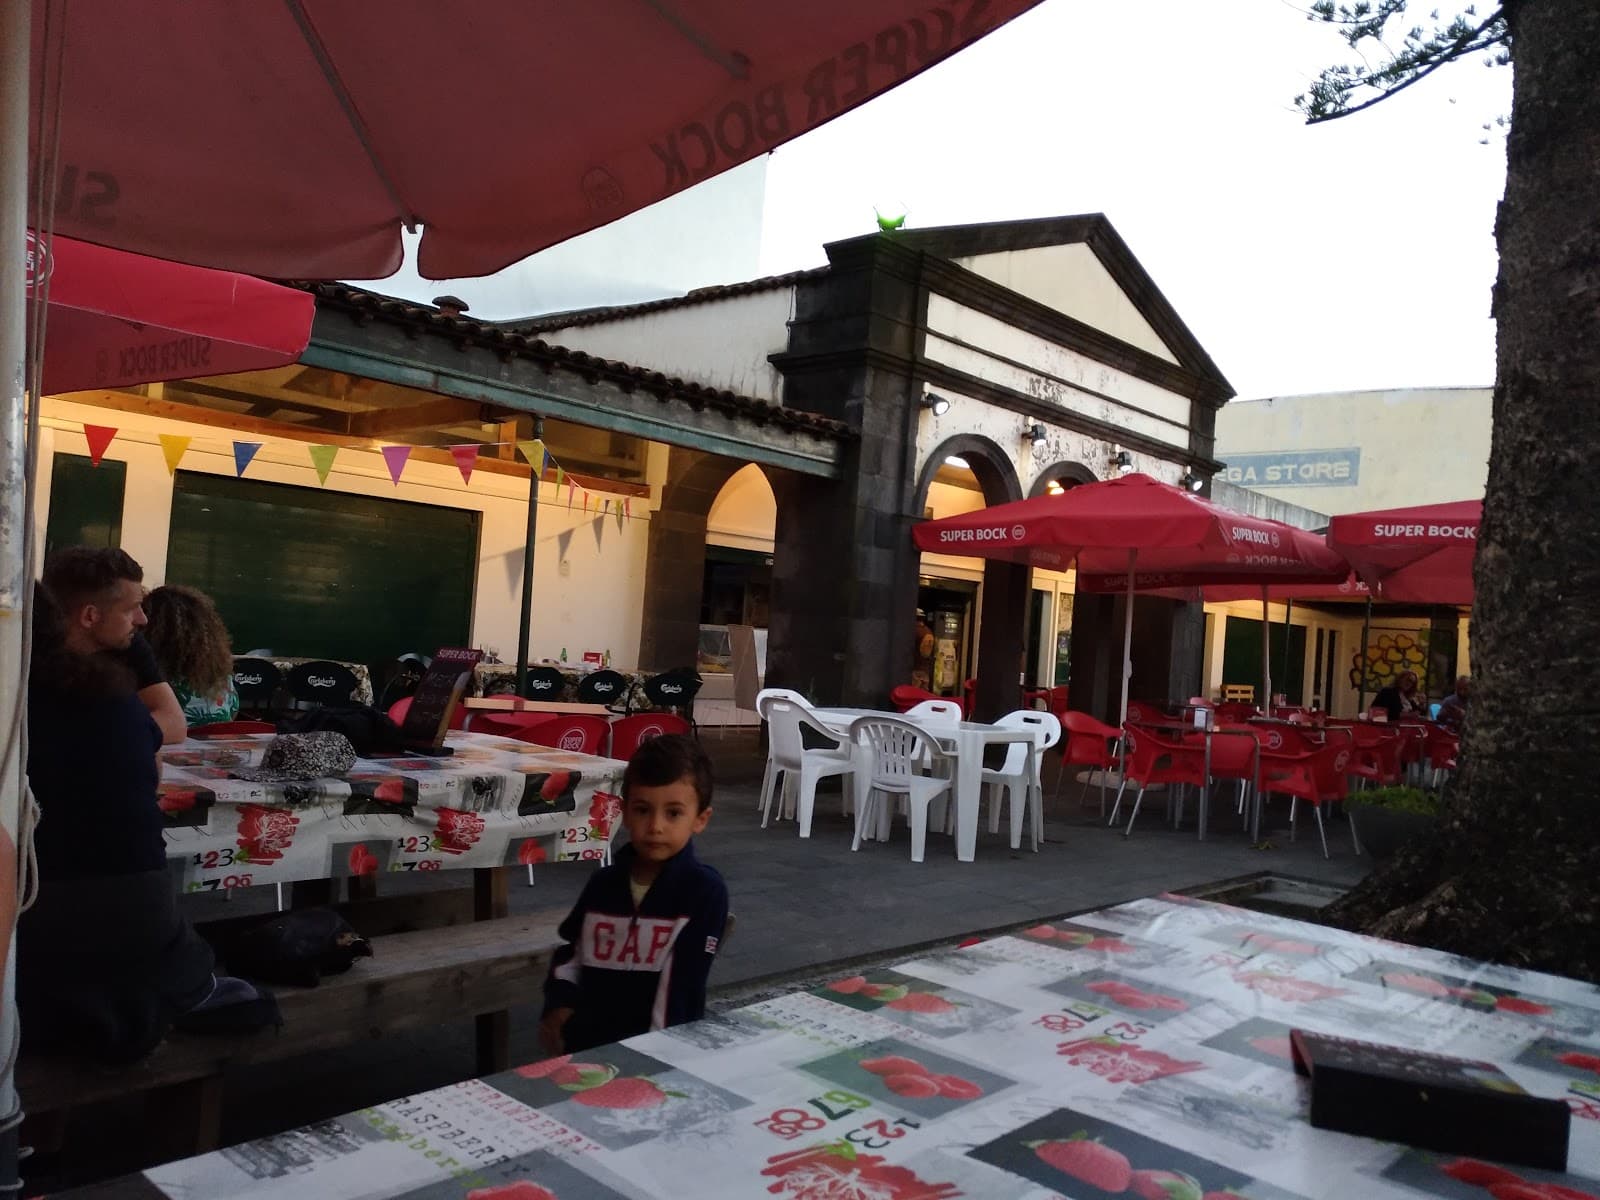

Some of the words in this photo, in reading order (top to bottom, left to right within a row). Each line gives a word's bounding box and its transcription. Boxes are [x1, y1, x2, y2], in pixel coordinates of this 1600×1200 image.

[1265, 461, 1351, 481] STORE
[940, 529, 974, 543] SUPER
[976, 527, 1007, 541] BOCK
[1232, 526, 1254, 543] SUPER
[1254, 529, 1270, 545] BOCK
[1374, 524, 1424, 537] SUPER
[1428, 525, 1476, 539] BOCK
[234, 672, 263, 685] Carlsberg
[307, 675, 336, 688] Carlsberg
[559, 826, 589, 843] 123
[397, 835, 430, 853] 123
[193, 848, 235, 869] 123
[593, 921, 674, 964] GAP
